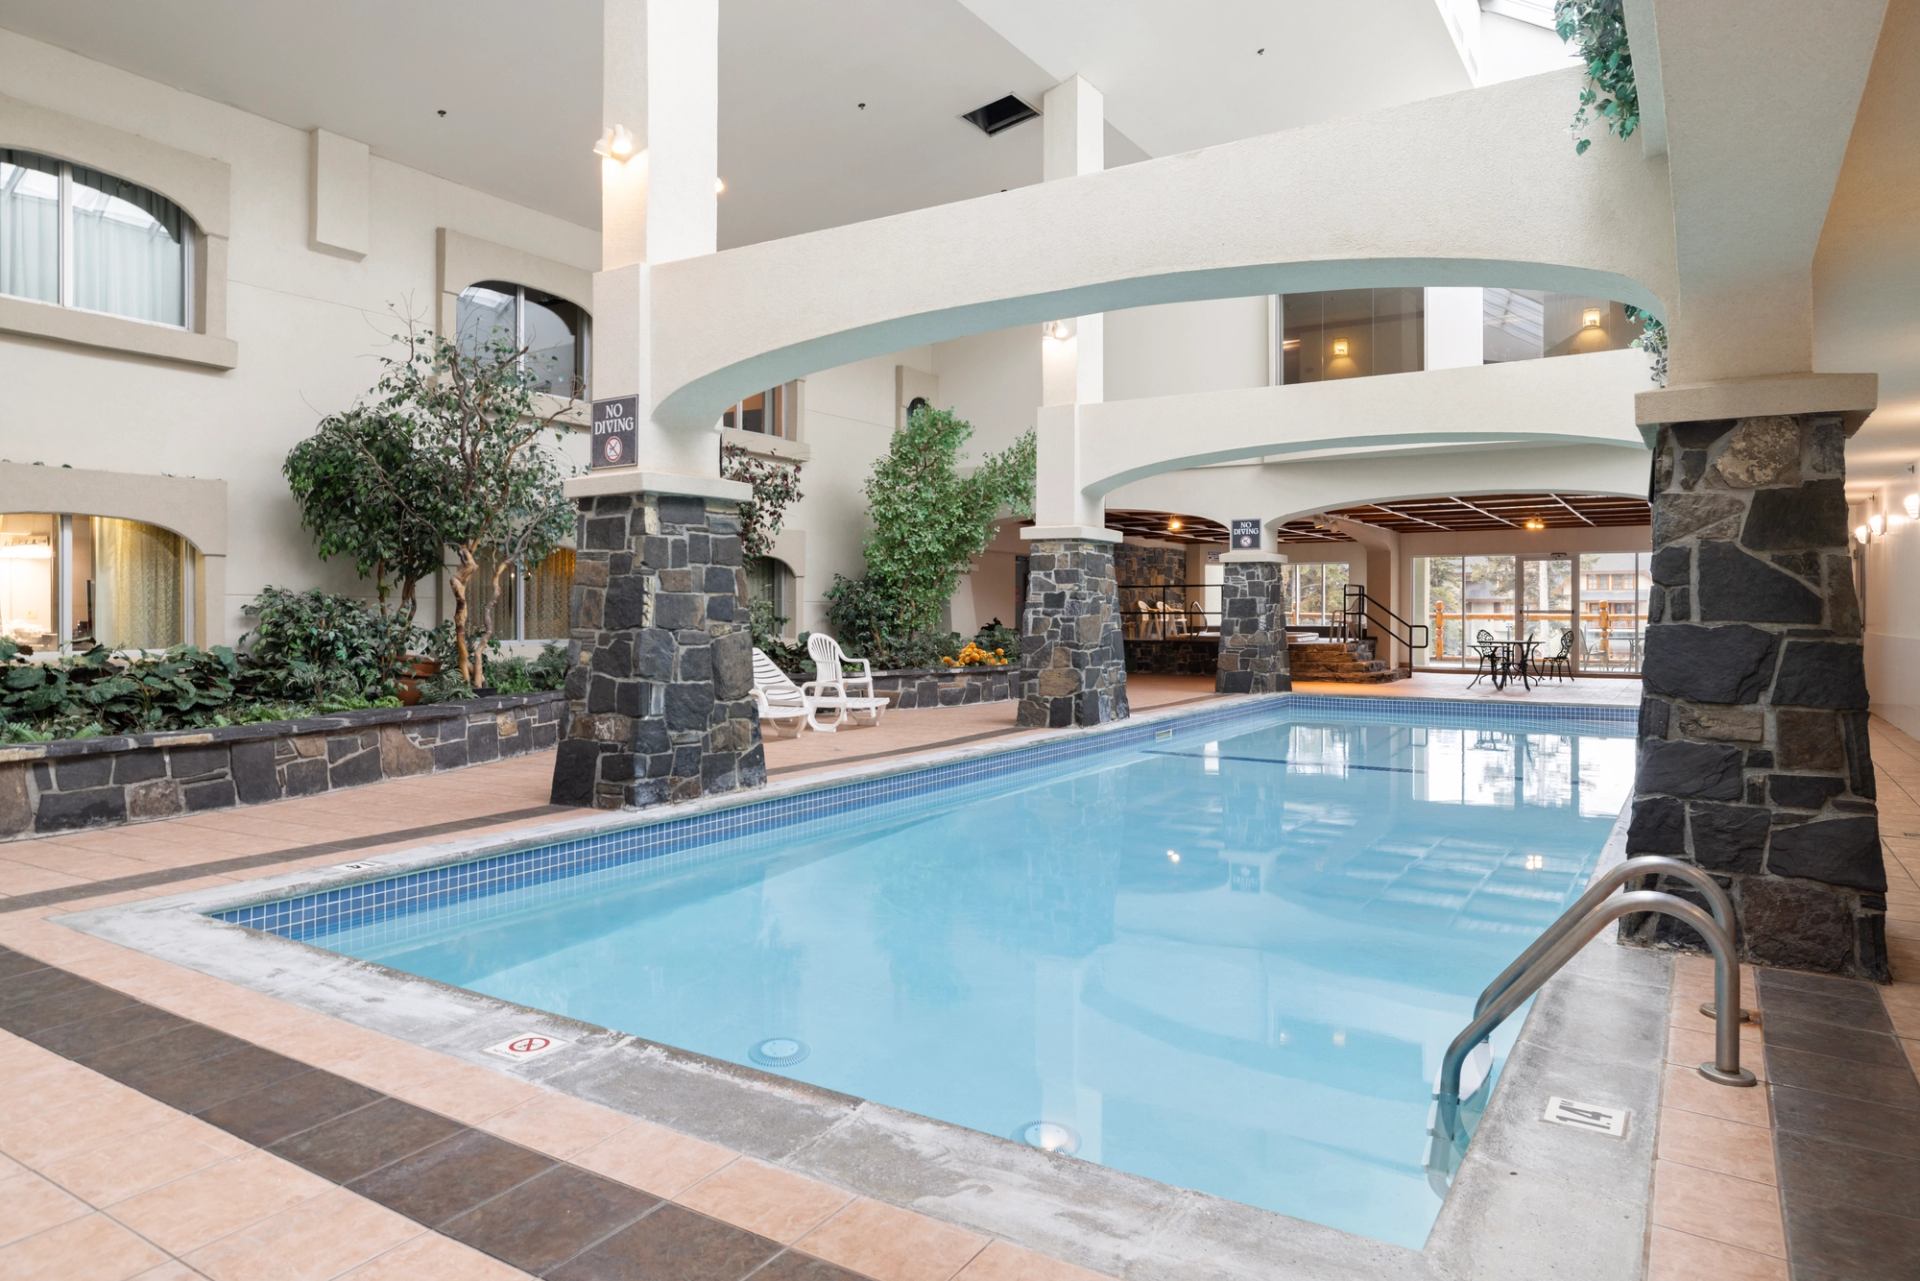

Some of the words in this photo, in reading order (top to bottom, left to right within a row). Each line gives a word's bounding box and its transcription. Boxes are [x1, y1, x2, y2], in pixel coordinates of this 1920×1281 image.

[605, 403, 623, 419] NO
[594, 417, 634, 435] DIVING
[1240, 521, 1252, 529] NO
[1233, 527, 1260, 536] DIVING
